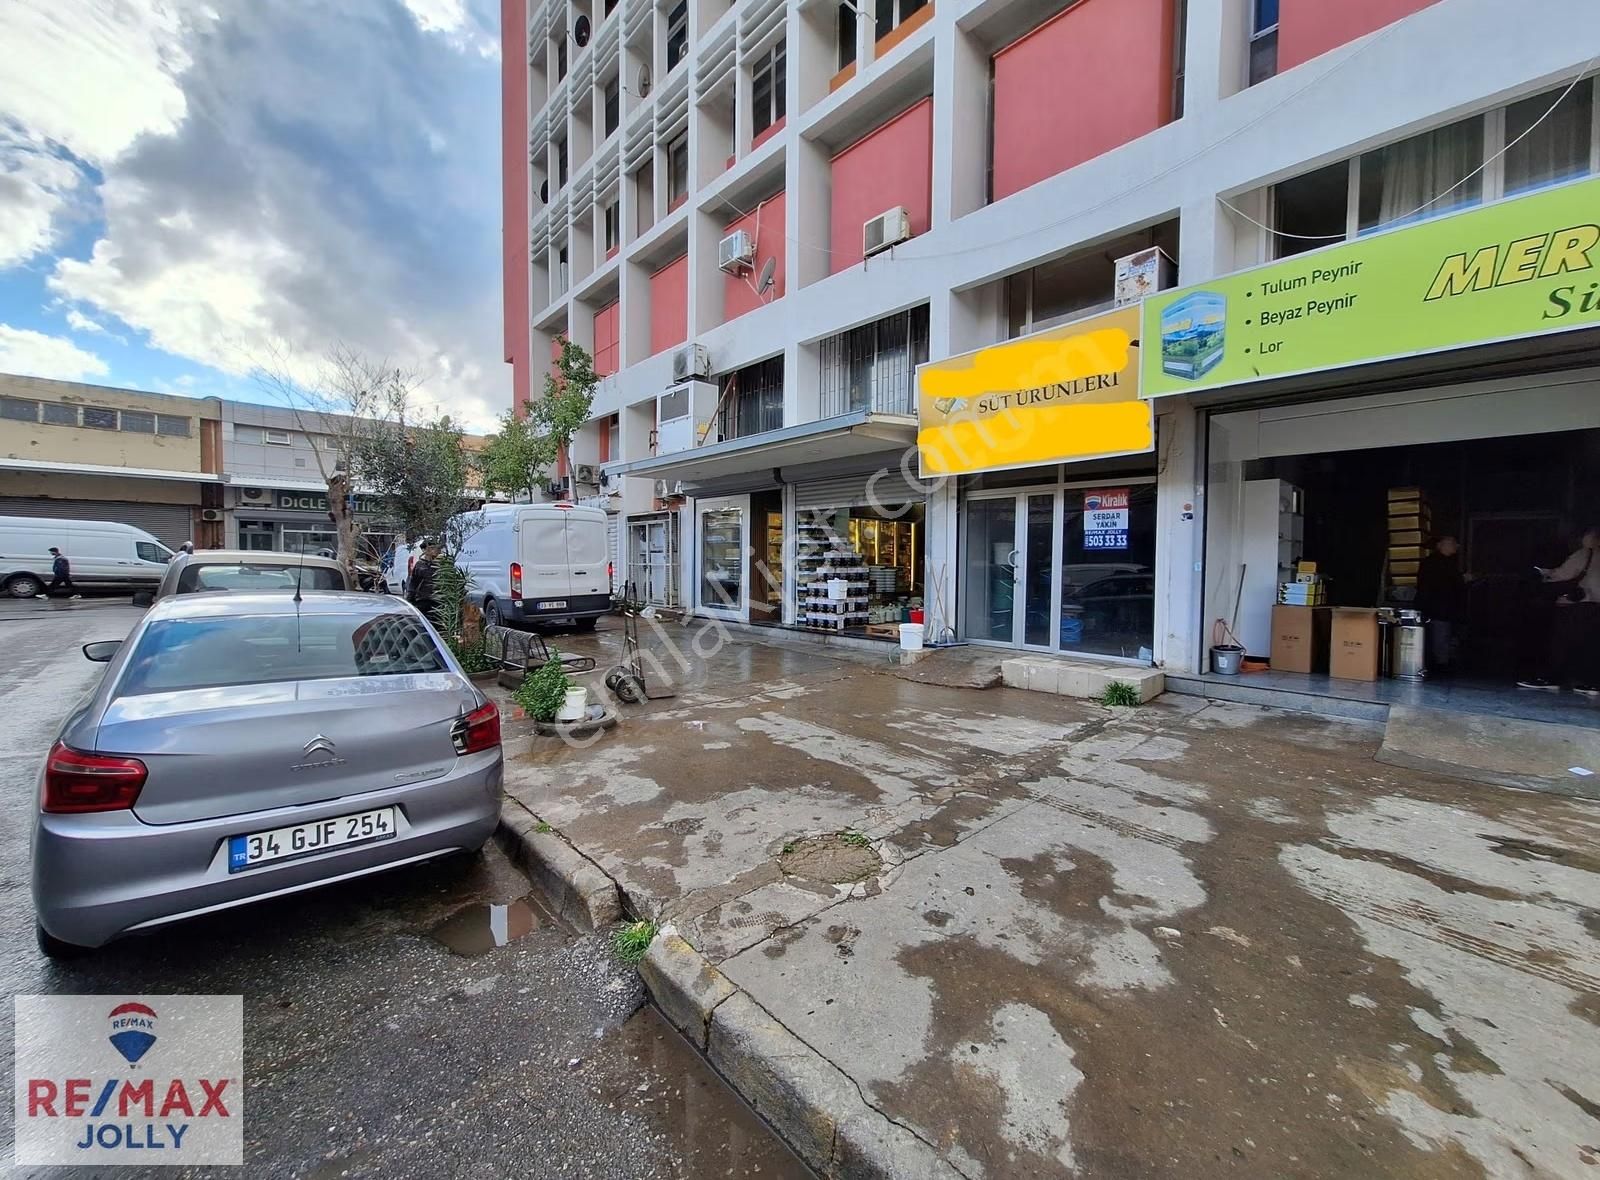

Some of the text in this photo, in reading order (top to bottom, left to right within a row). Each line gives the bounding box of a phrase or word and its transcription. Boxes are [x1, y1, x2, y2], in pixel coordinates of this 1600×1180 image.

[1260, 260, 1363, 295] Tulum Peynir
[1260, 292, 1358, 326] Beyaz Peynir
[1259, 340, 1284, 355] Lor
[979, 394, 1011, 414] SÜT
[1092, 512, 1121, 520] SERDAR
[1088, 535, 1103, 546] 503
[1104, 534, 1116, 546] 33
[1116, 534, 1127, 546] 33
[233, 853, 247, 862] TR
[248, 834, 281, 860] 34
[292, 821, 337, 851] GJF
[347, 813, 388, 840] 254
